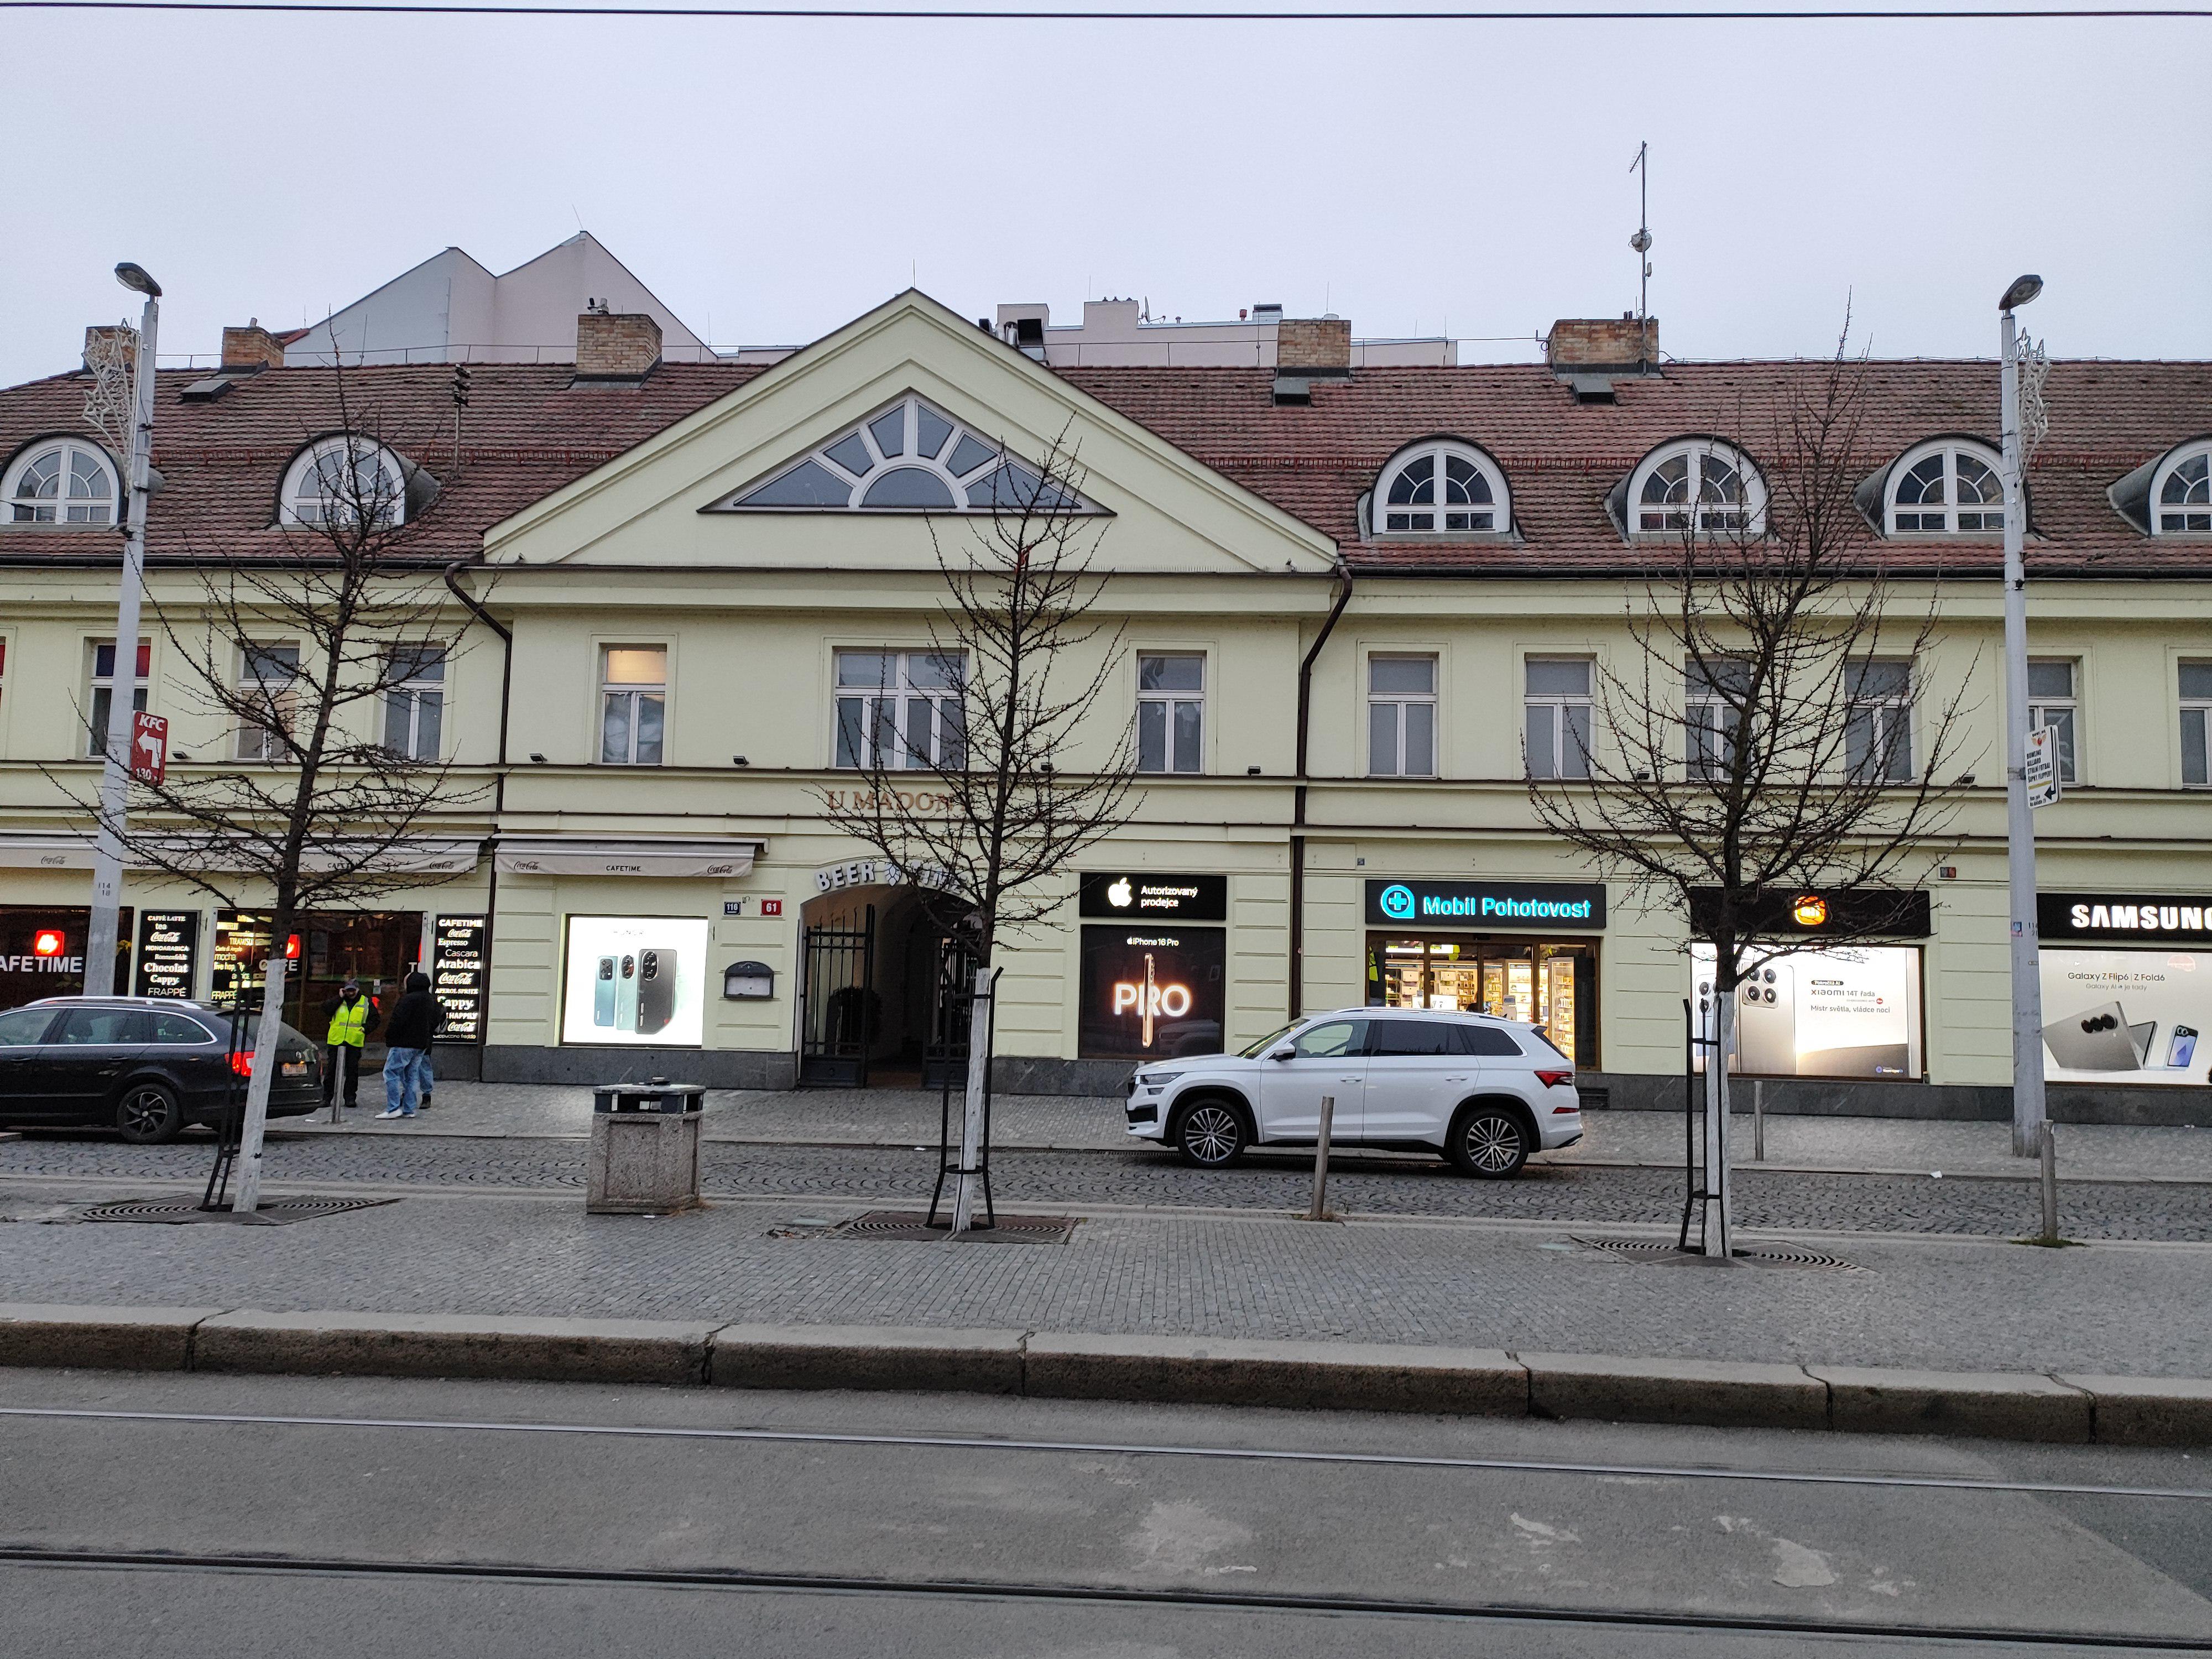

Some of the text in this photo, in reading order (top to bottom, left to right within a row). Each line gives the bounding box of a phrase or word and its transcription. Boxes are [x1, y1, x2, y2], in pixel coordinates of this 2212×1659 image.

[139, 714, 164, 731] KFC
[827, 791, 967, 811] U MADON
[815, 862, 875, 891] BEER
[1141, 885, 1198, 898] Autorizovaný
[766, 902, 777, 912] 61
[1141, 897, 1179, 909] prodejce
[1423, 896, 1592, 918] Mobil Pohotovost
[439, 919, 483, 927] CAFETIME
[437, 938, 468, 947] Espresso
[1133, 937, 1157, 946] iPhone
[214, 952, 236, 961] mocha
[445, 949, 478, 957] Cascara
[144, 962, 189, 973] Chocolat
[436, 958, 481, 969] Arabica
[2068, 972, 2100, 982] Galaxy
[2109, 973, 2129, 982] Flip6
[148, 987, 186, 997] FRAPPÉ
[1114, 984, 1190, 1017] PRO
